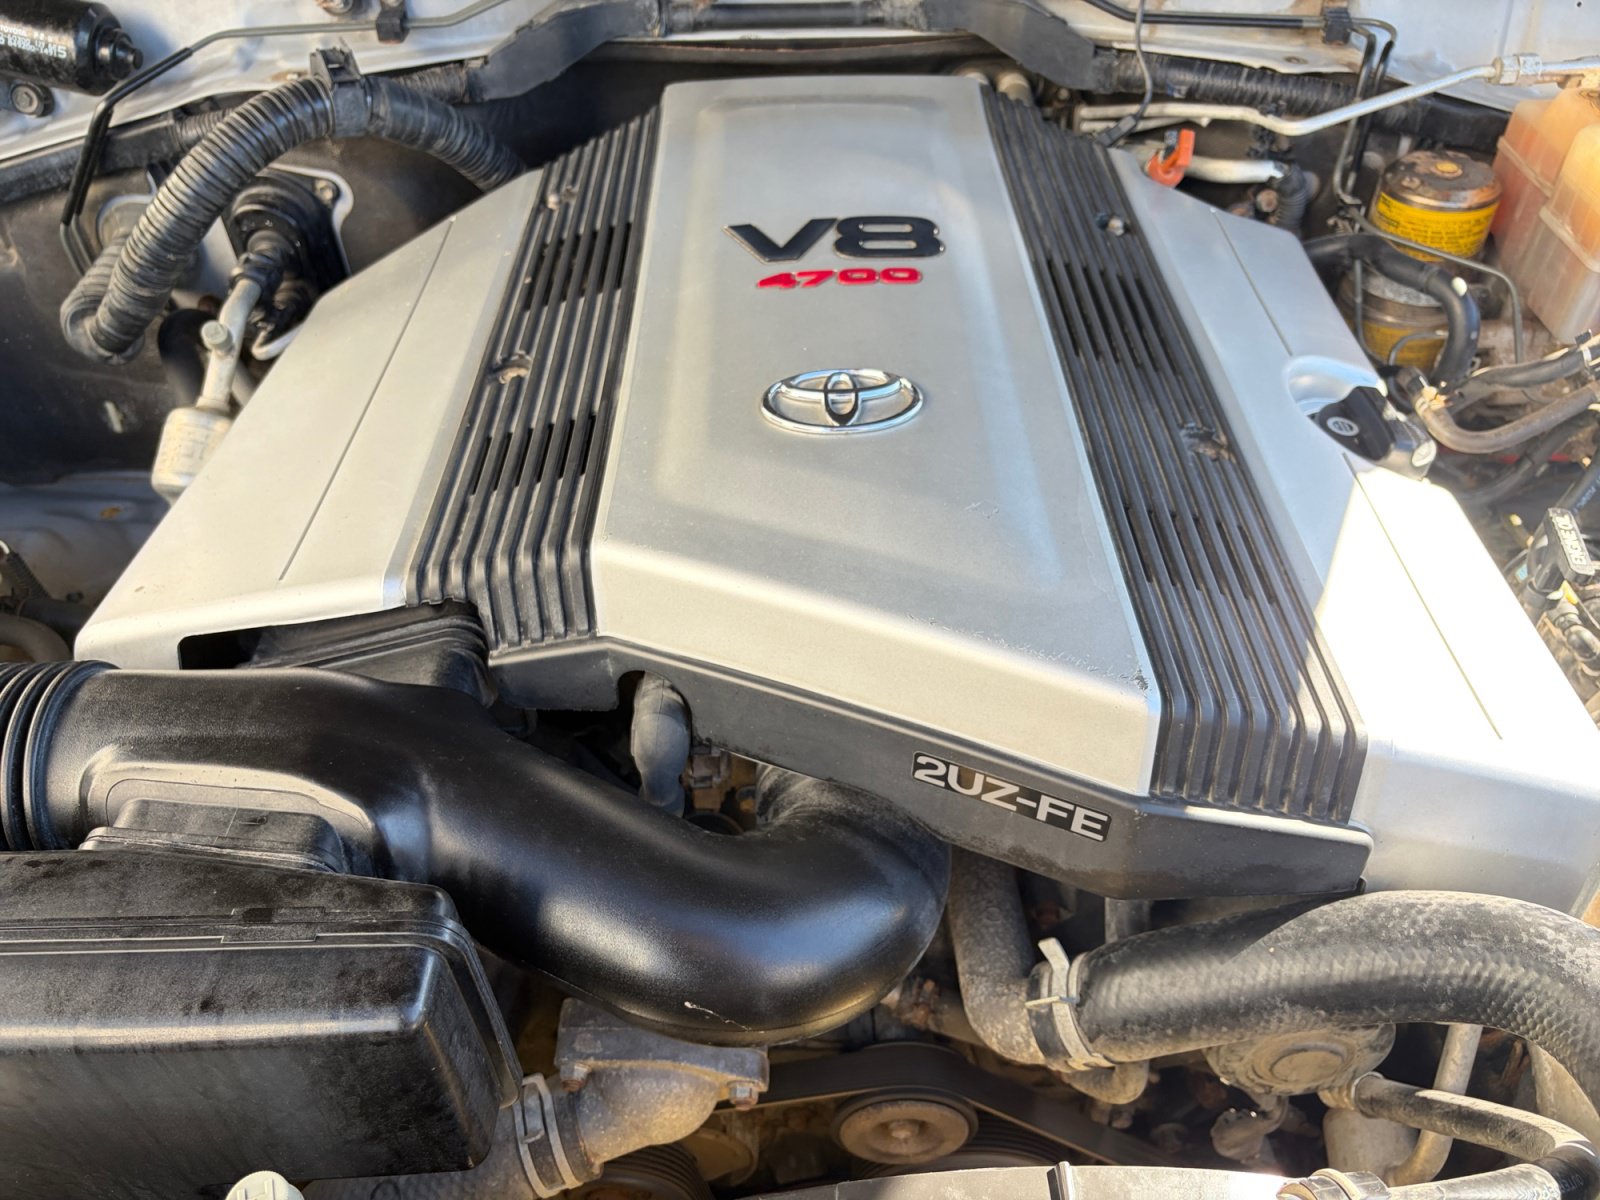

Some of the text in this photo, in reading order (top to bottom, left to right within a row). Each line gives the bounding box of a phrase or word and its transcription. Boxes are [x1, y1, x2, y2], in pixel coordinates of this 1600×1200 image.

[722, 215, 945, 264] V8
[756, 267, 922, 288] 4700
[1561, 529, 1587, 566] ENGINE
[913, 755, 1109, 842] 2UZ-FE
